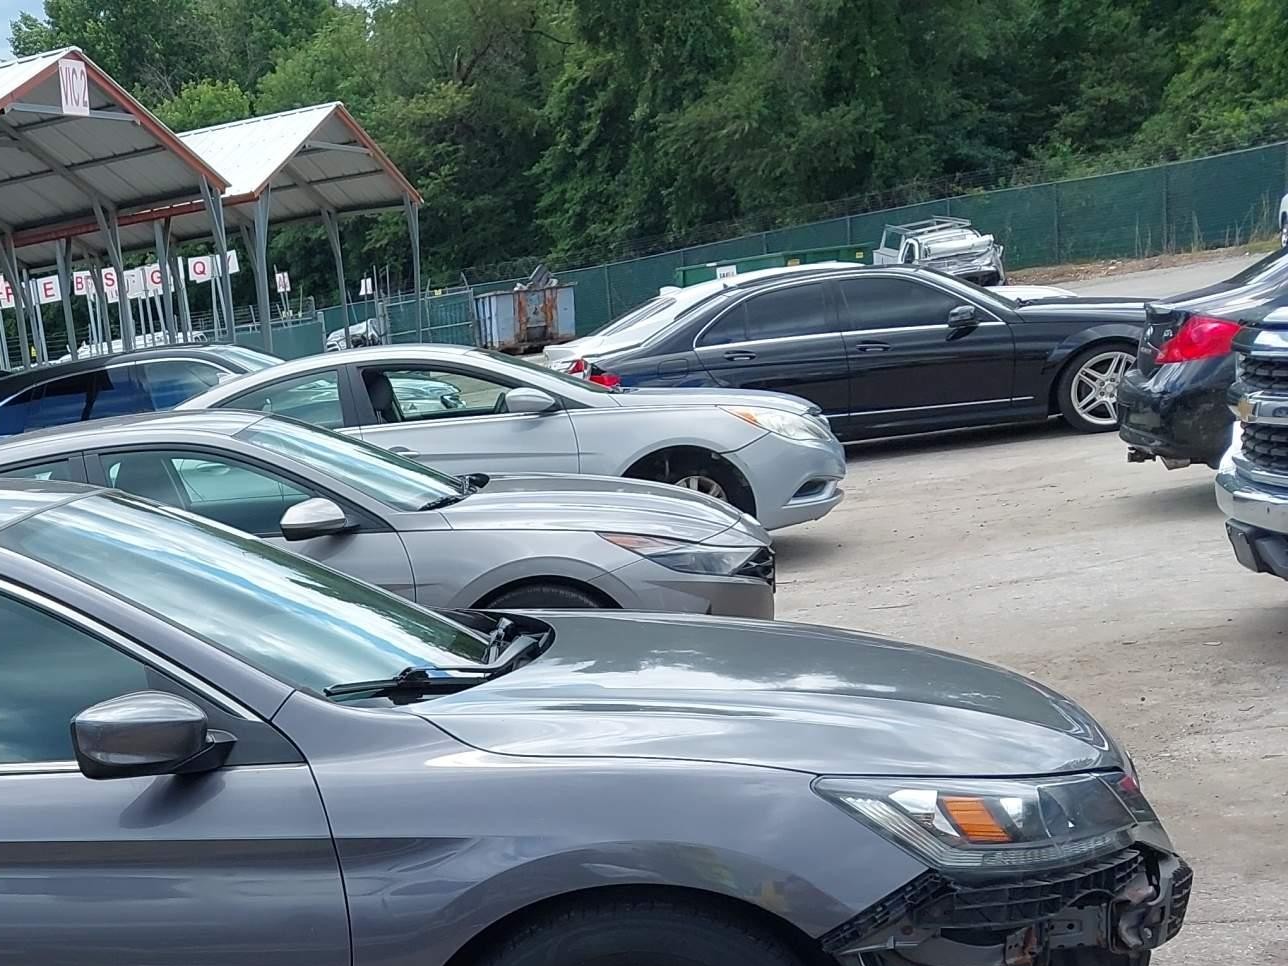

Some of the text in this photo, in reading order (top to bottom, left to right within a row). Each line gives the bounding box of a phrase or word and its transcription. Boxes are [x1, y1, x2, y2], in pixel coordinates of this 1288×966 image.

[193, 261, 206, 276] Q
[75, 276, 84, 291] B
[104, 272, 115, 287] S
[151, 270, 162, 284] G
[43, 281, 55, 298] E
